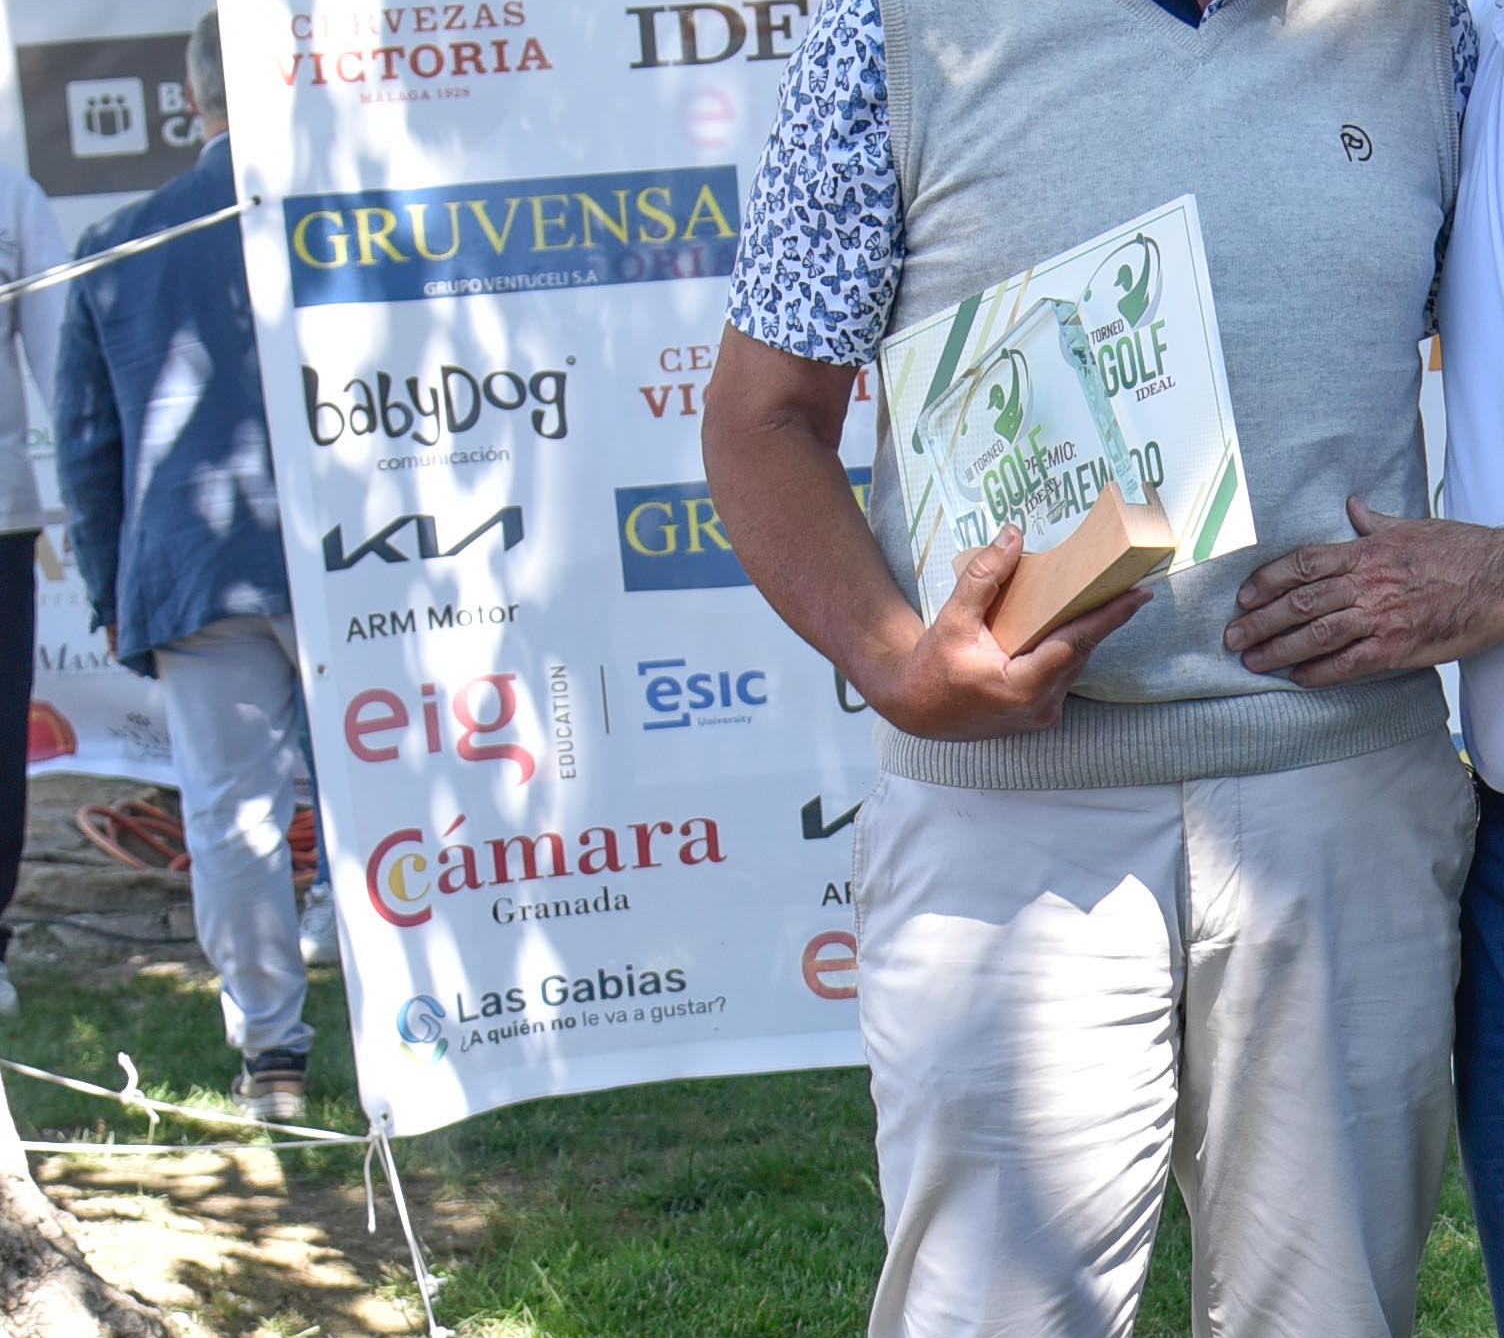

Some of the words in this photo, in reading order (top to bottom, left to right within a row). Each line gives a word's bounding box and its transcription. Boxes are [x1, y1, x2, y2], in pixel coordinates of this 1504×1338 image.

[276, 36, 553, 87] VICTORIA
[294, 183, 738, 269] GRUVENSA
[423, 279, 482, 297] GRUPO
[1098, 318, 1168, 398] GOLF
[1135, 376, 1176, 402] IDEAL
[983, 424, 1048, 522] GOLF
[346, 604, 417, 642] ARM
[428, 601, 520, 630] Motor
[344, 672, 536, 786] eig
[549, 664, 577, 780] EDUCATION
[366, 813, 728, 929] Cámara
[491, 886, 631, 925] Granada
[456, 986, 527, 1024] Las
[541, 964, 688, 1007] Gabias
[487, 1021, 545, 1046] quién
[551, 1016, 577, 1031] no
[582, 1010, 599, 1028] le
[604, 1010, 628, 1025] va
[633, 1008, 645, 1023] a
[650, 995, 727, 1024] gustar?
